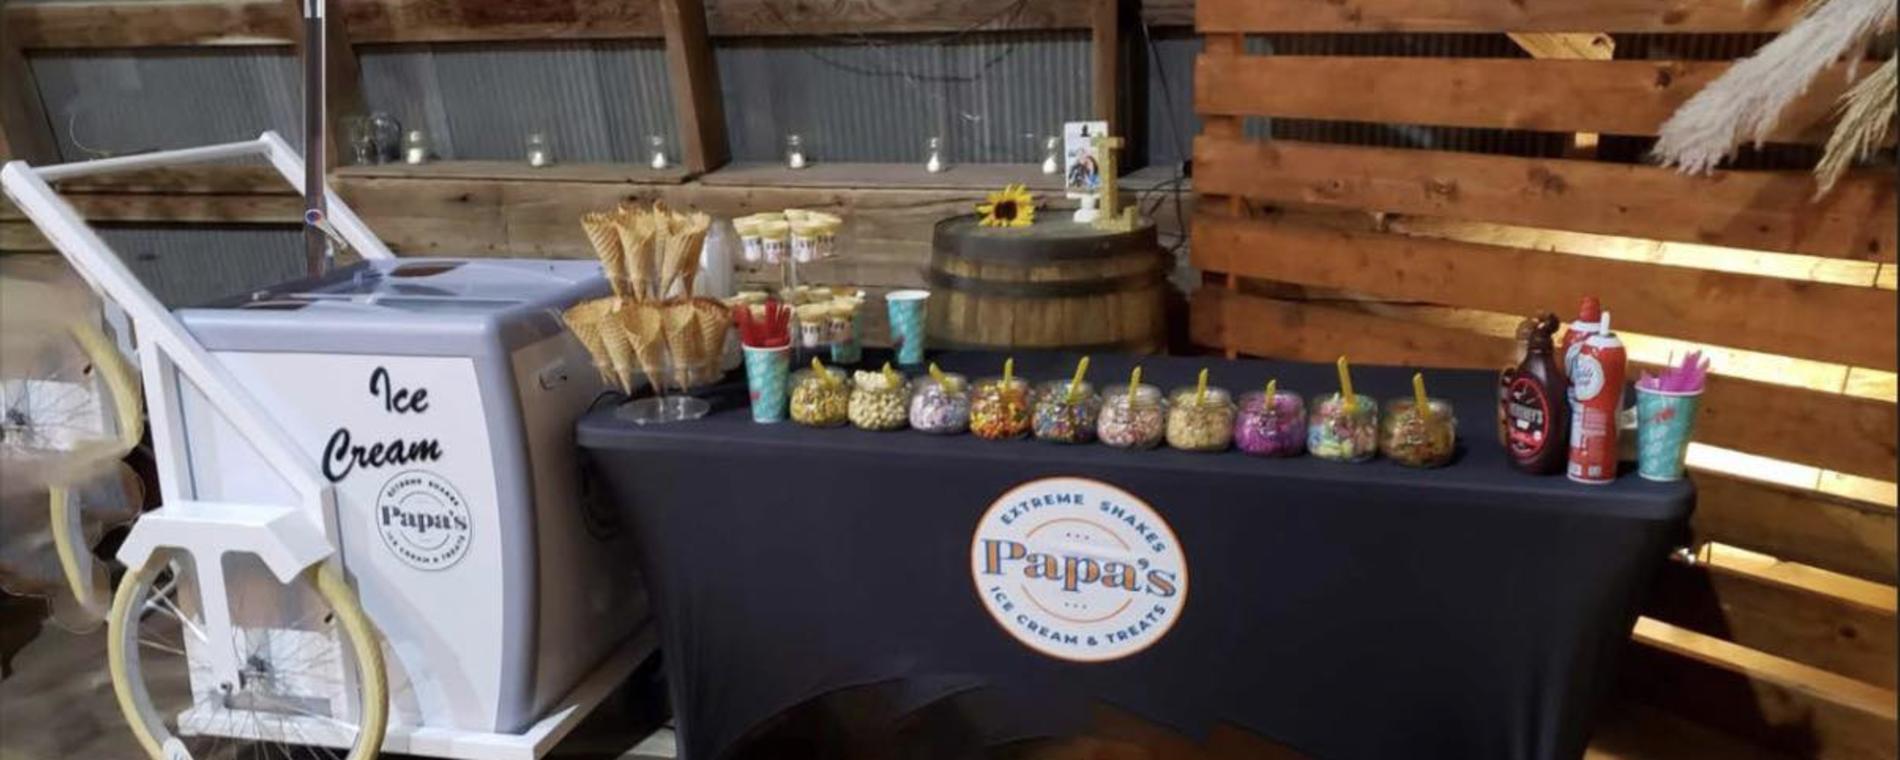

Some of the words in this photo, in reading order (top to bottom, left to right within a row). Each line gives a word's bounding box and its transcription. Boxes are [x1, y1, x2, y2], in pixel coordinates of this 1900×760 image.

[369, 366, 429, 414] Ice
[321, 427, 443, 484] Cream
[381, 505, 468, 533] Papa's
[999, 493, 1085, 525] EXTREME
[1099, 500, 1166, 553] SHAKES
[981, 537, 1177, 599] Papa's
[990, 585, 1015, 613] ICE
[1016, 613, 1079, 646] CREAM
[1087, 635, 1099, 647] &
[1106, 603, 1167, 647] TREATS
